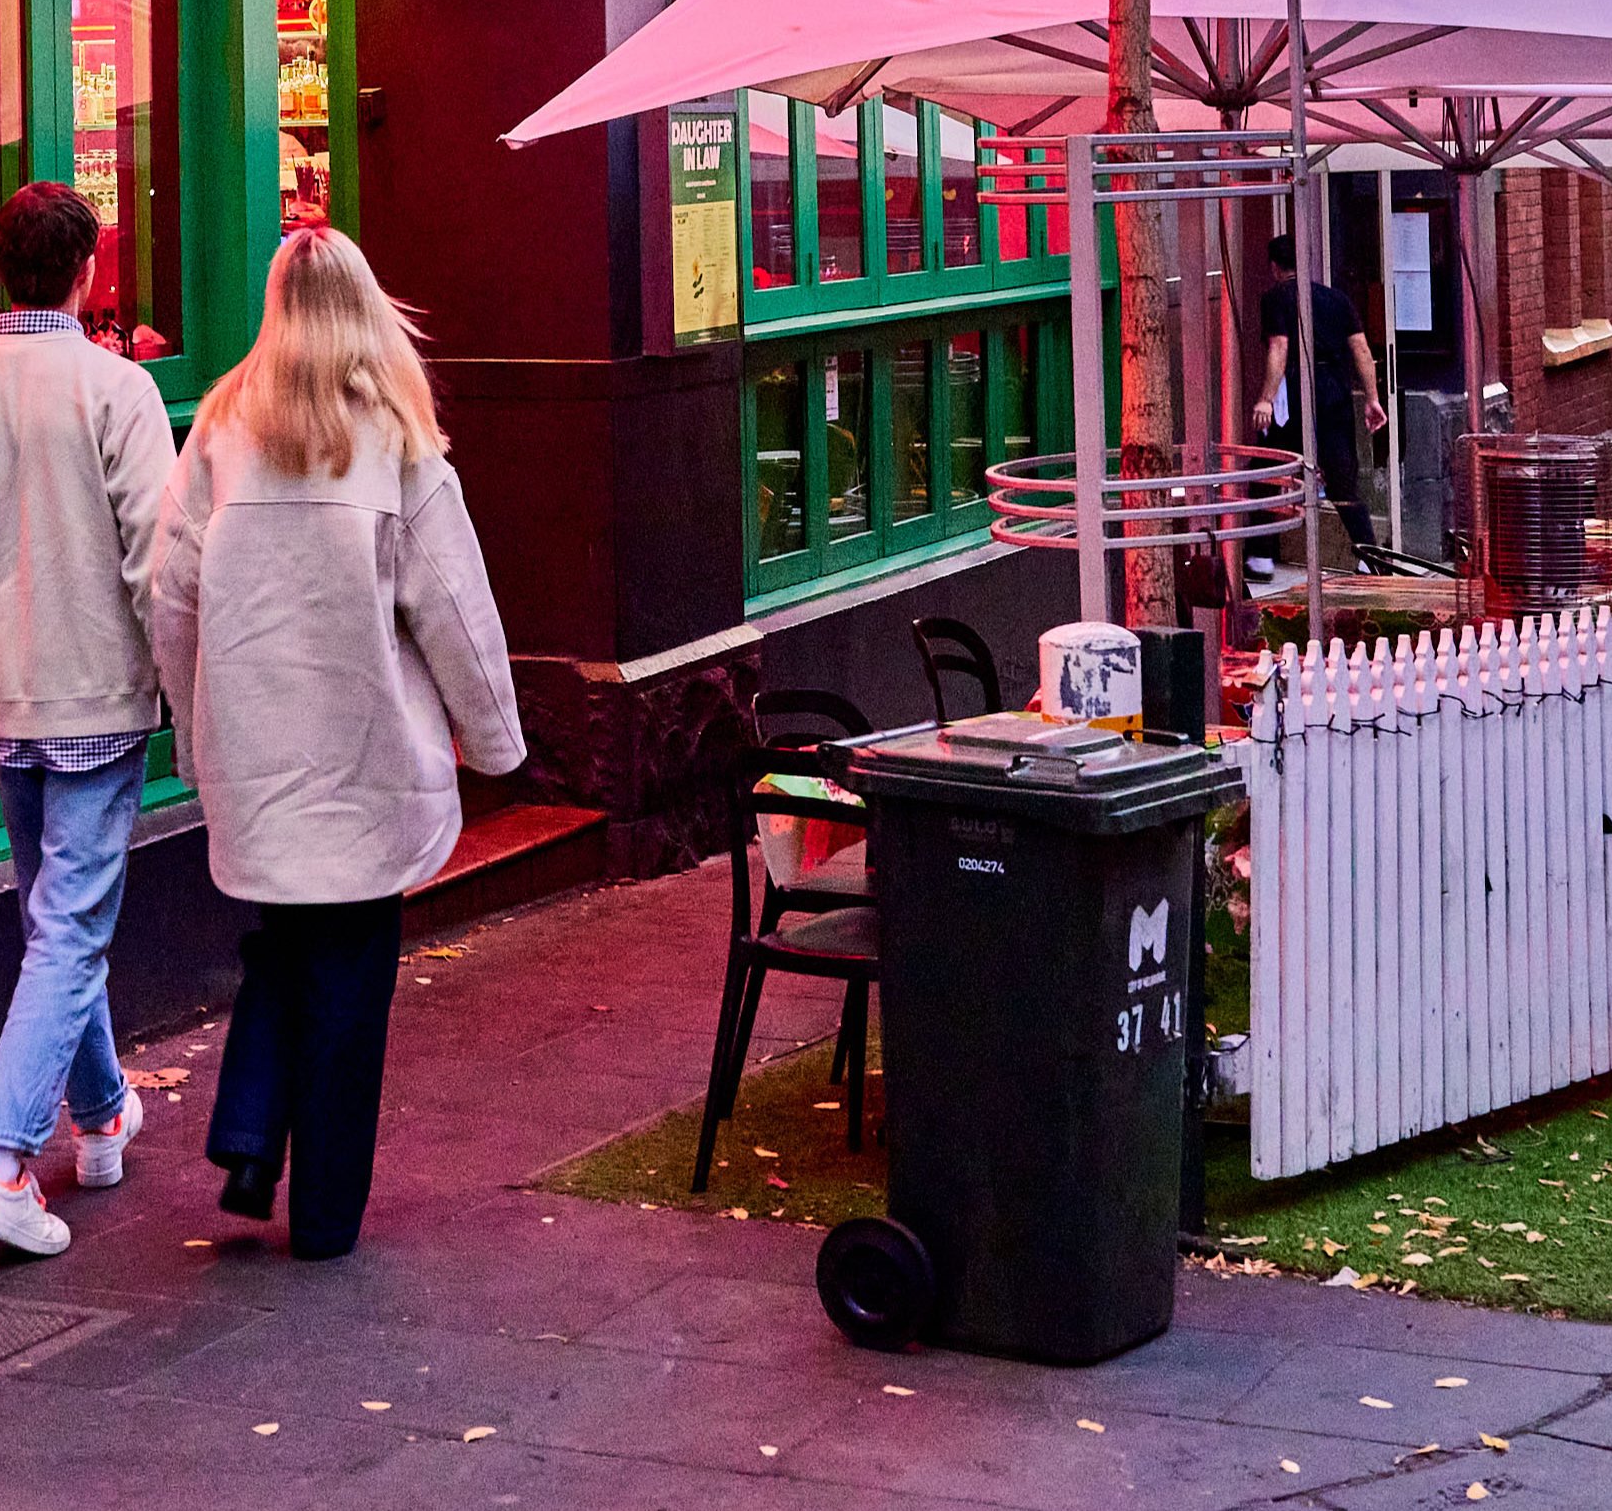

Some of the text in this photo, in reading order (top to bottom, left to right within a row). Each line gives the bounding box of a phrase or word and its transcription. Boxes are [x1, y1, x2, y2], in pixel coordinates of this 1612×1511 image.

[671, 119, 733, 146] DAUGHTER
[683, 145, 721, 171] IN LAW
[958, 856, 1005, 874] 0204274
